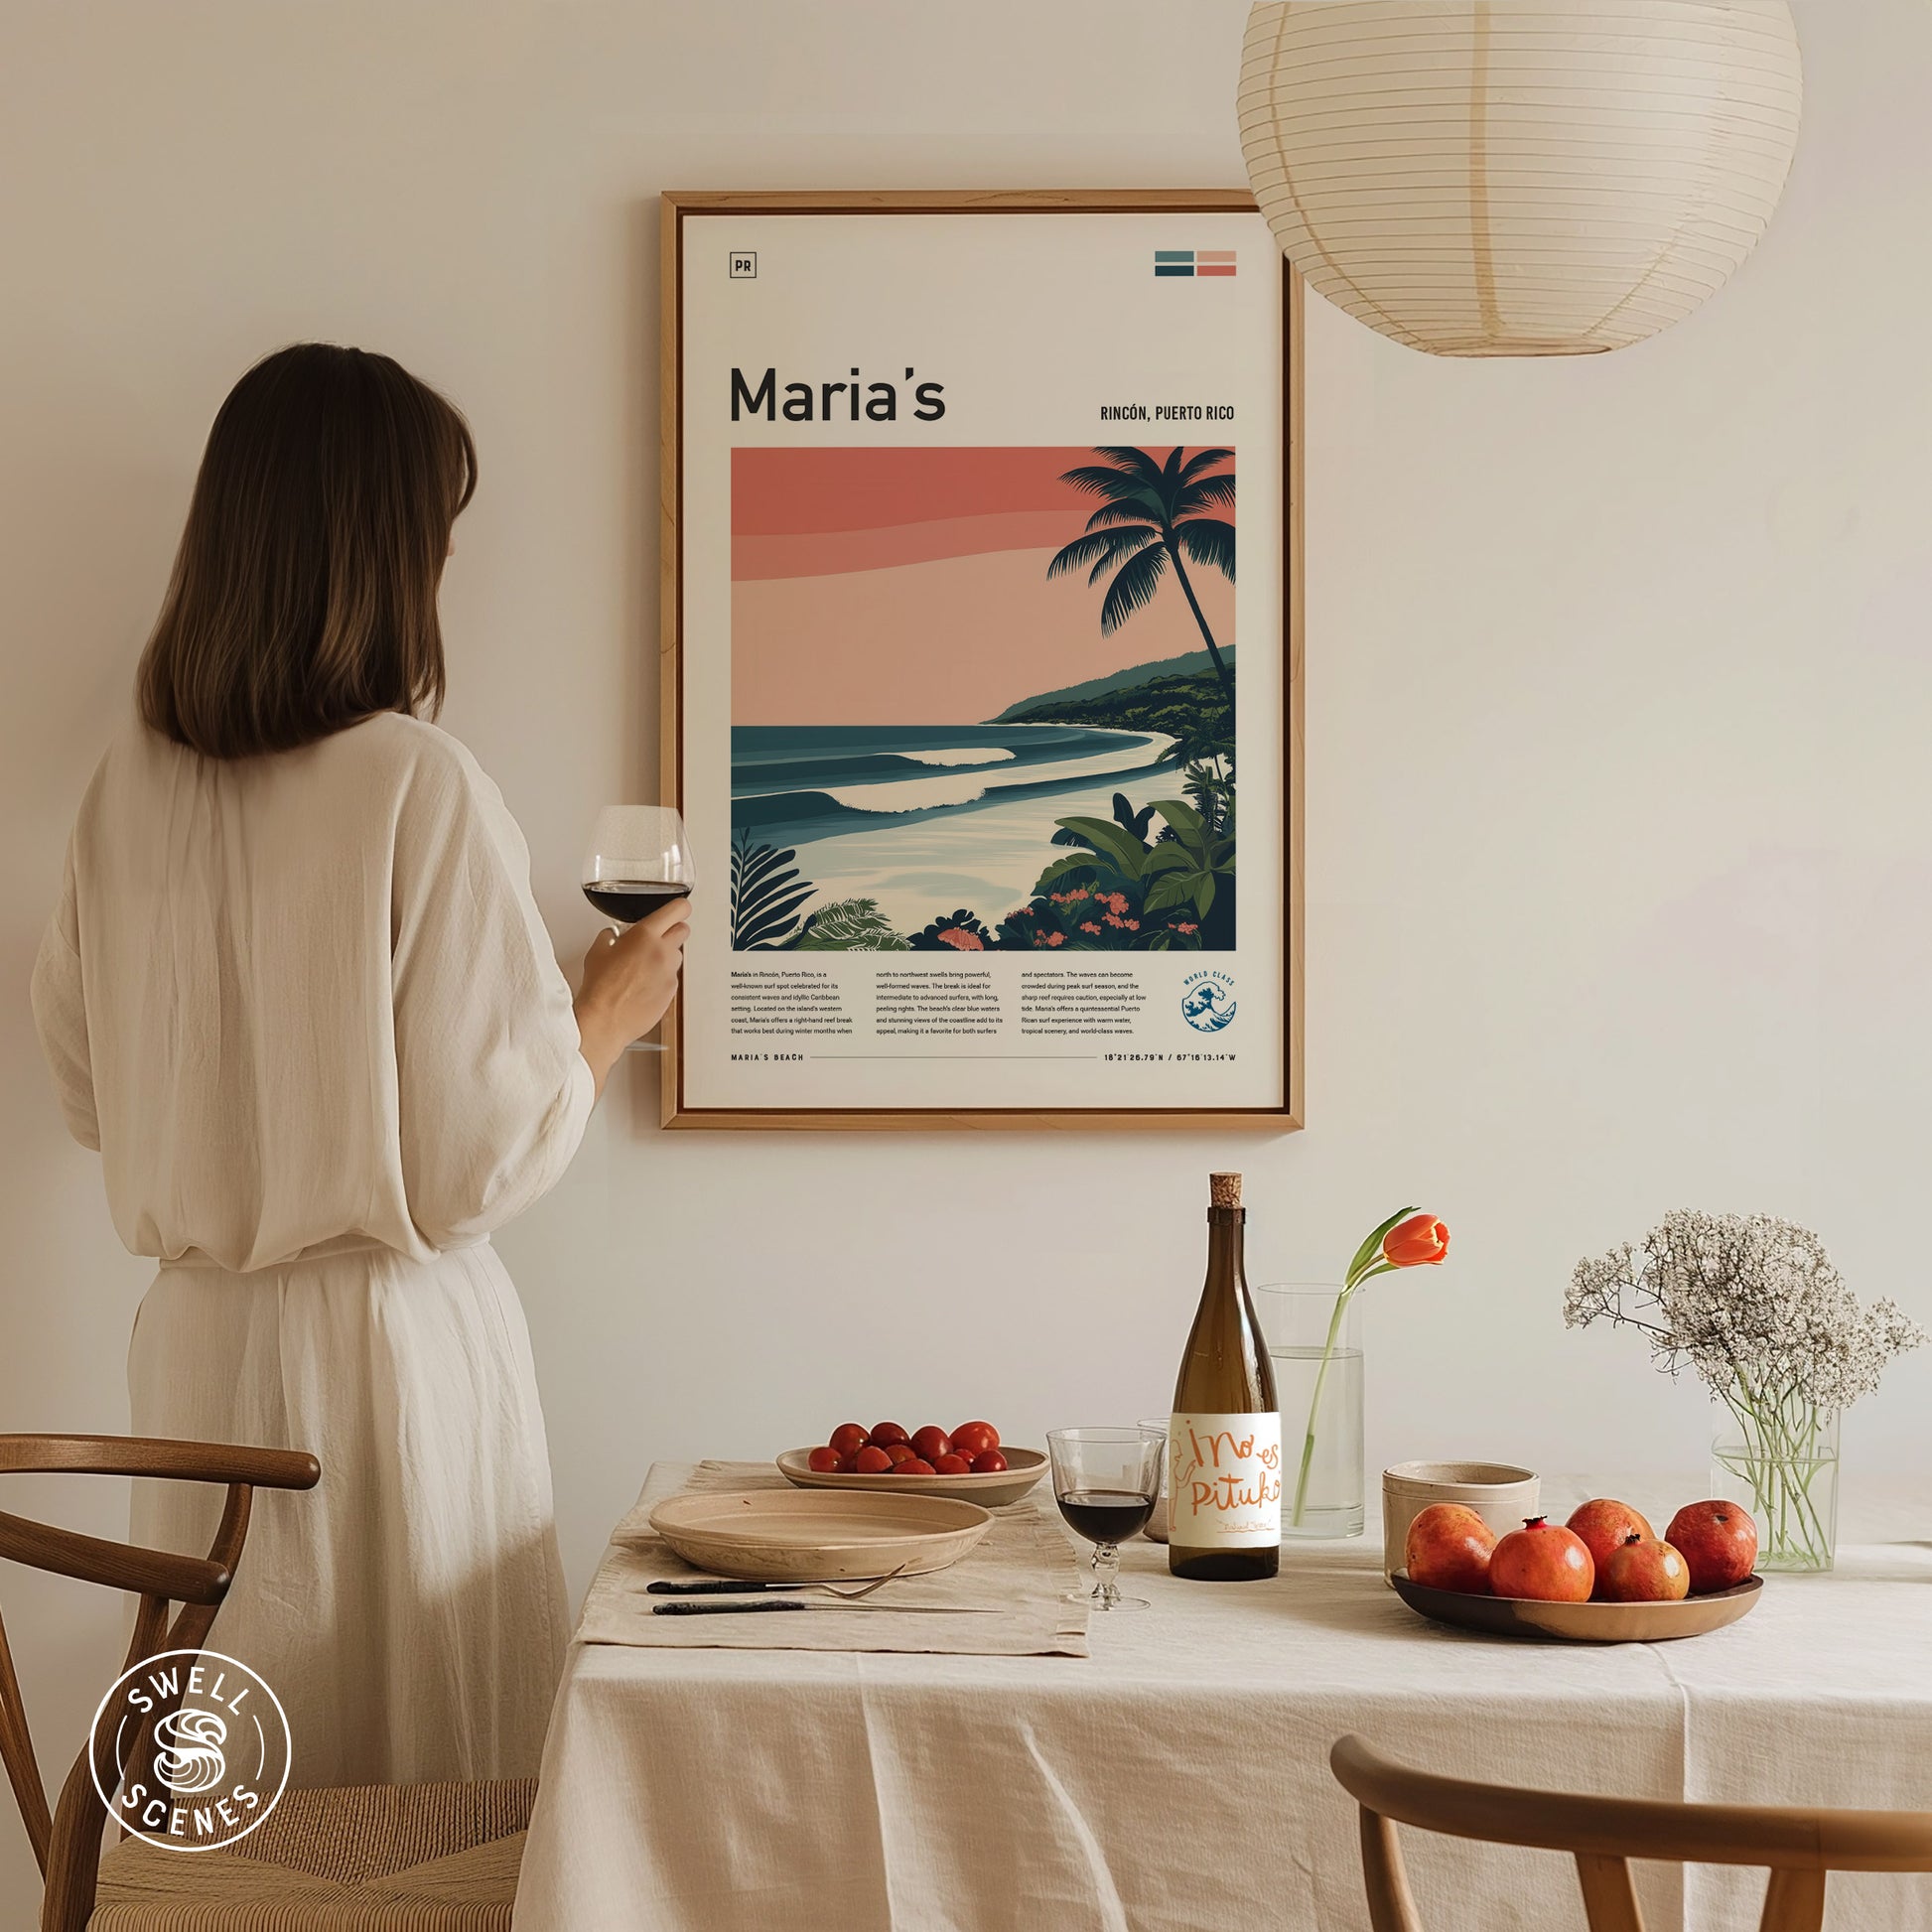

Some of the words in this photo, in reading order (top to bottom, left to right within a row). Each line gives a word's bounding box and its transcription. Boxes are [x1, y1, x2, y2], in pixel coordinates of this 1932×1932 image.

[735, 259, 752, 272] PR
[730, 367, 946, 422] Maria's
[1100, 404, 1152, 422] RINCÓN,
[1155, 406, 1202, 420] PUERTO
[1206, 406, 1235, 420] RICO
[1183, 971, 1207, 985] WORLD
[1213, 971, 1235, 986] CLASS
